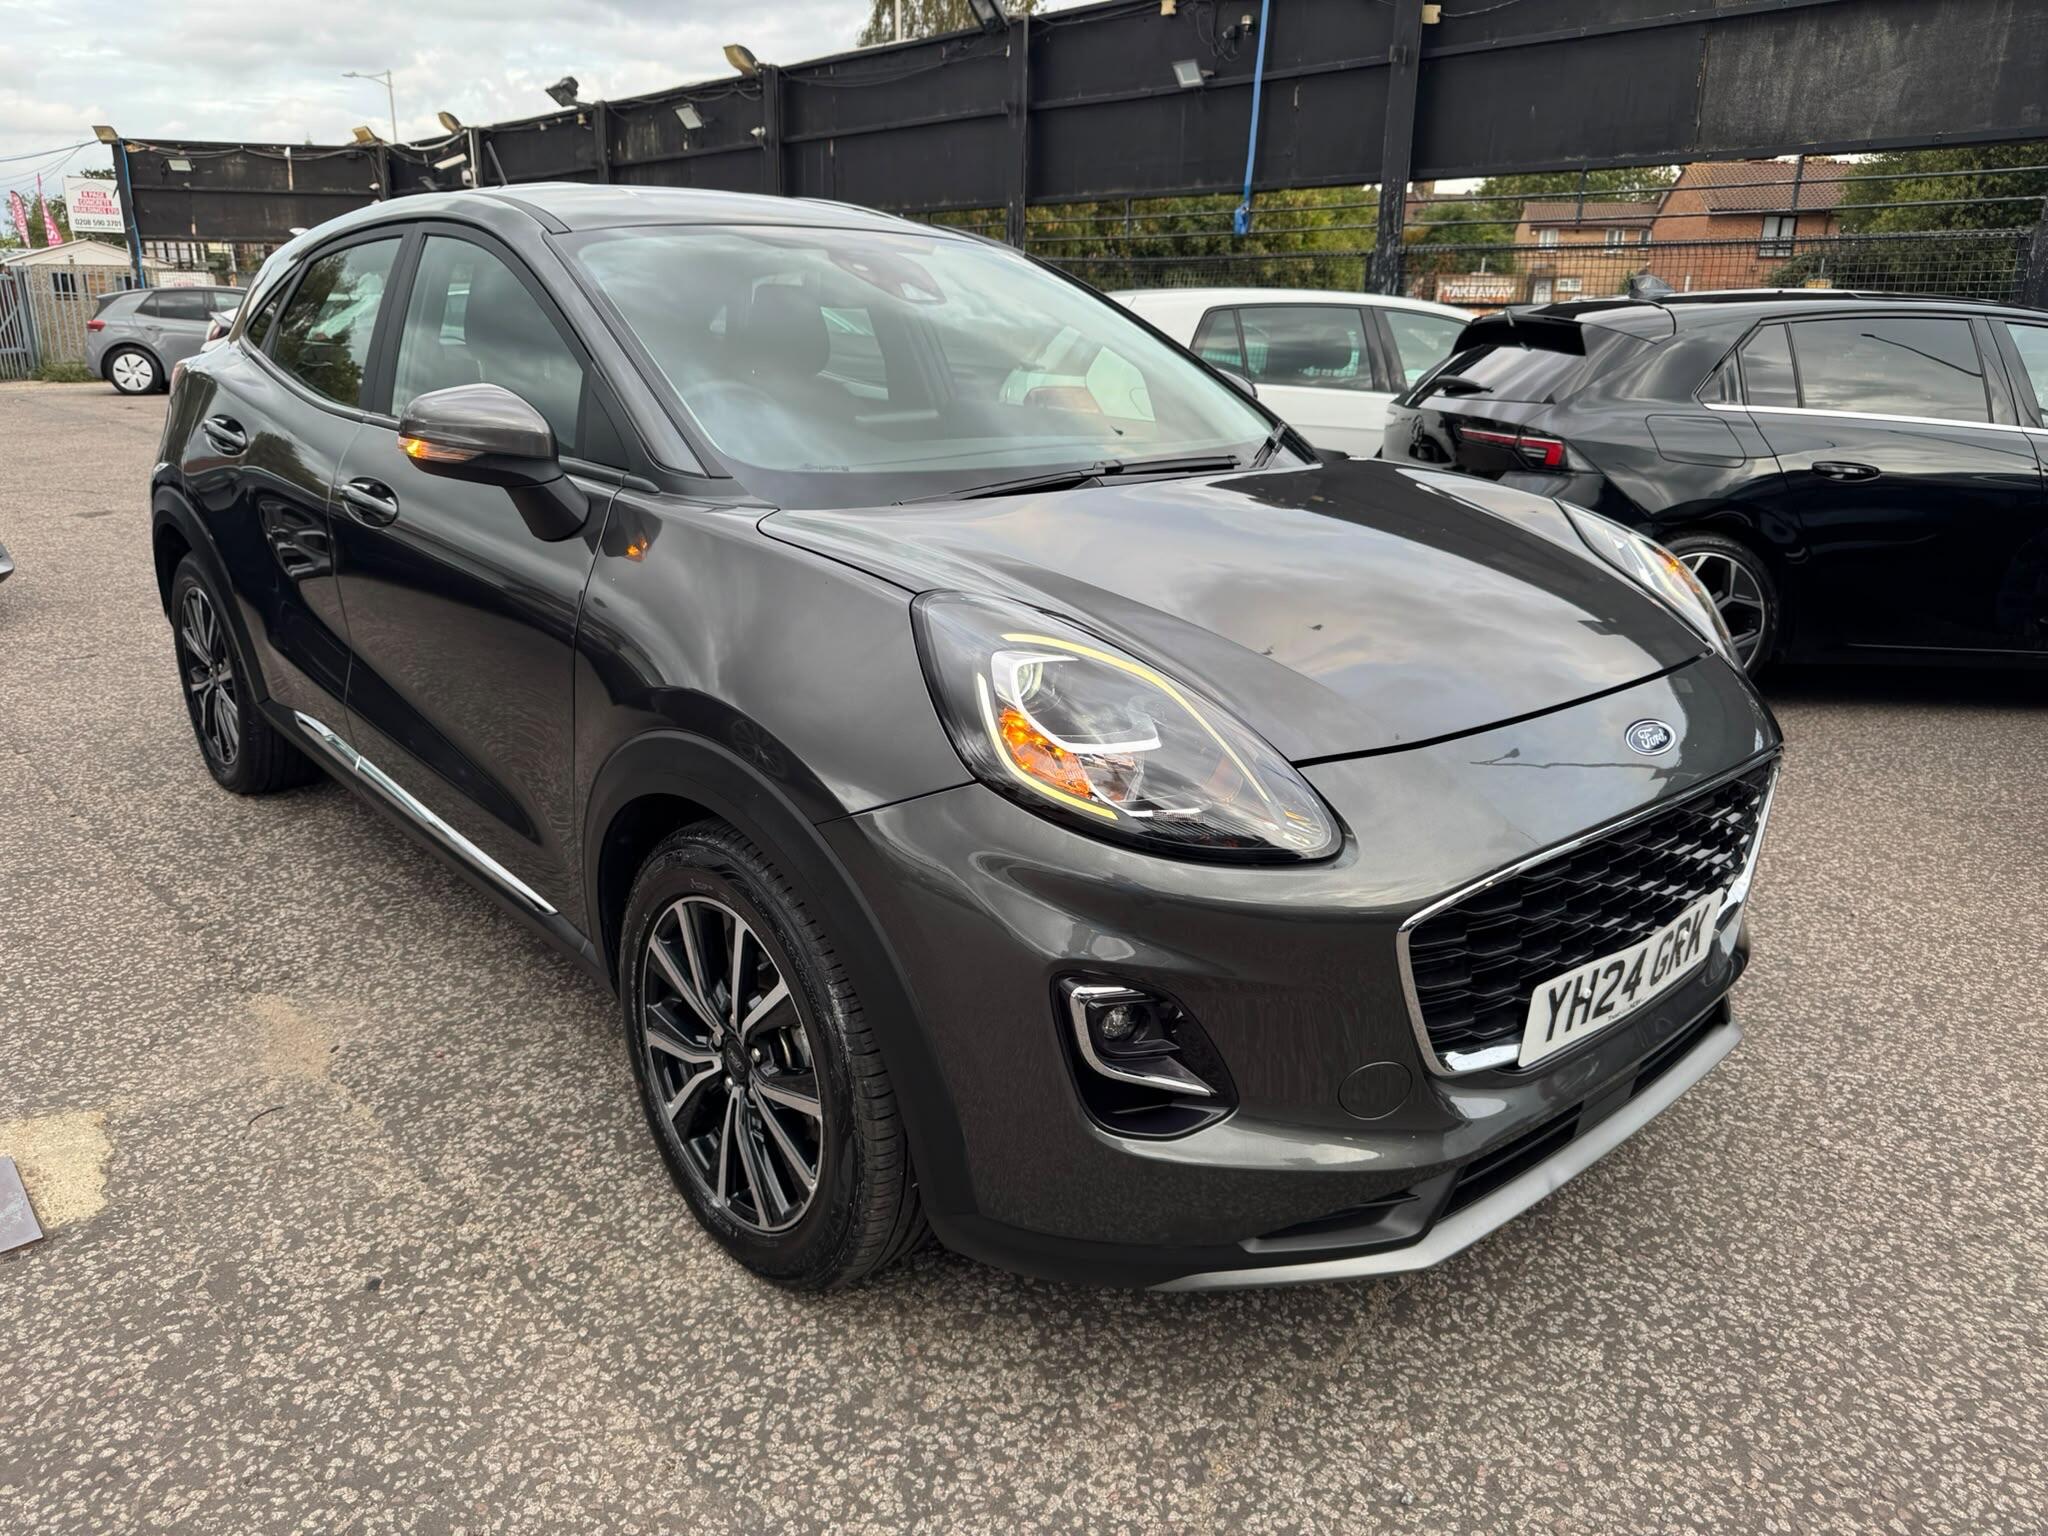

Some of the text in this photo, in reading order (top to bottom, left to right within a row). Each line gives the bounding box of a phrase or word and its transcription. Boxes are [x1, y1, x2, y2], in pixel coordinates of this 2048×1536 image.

[78, 198, 111, 206] CONCRETE
[73, 206, 119, 215] BUILDINGS LTD
[75, 218, 91, 226] 0208
[1443, 285, 1516, 298] TAKEAWAY
[1637, 727, 1668, 749] Ford
[1545, 903, 1711, 1042] YH24 GRK
